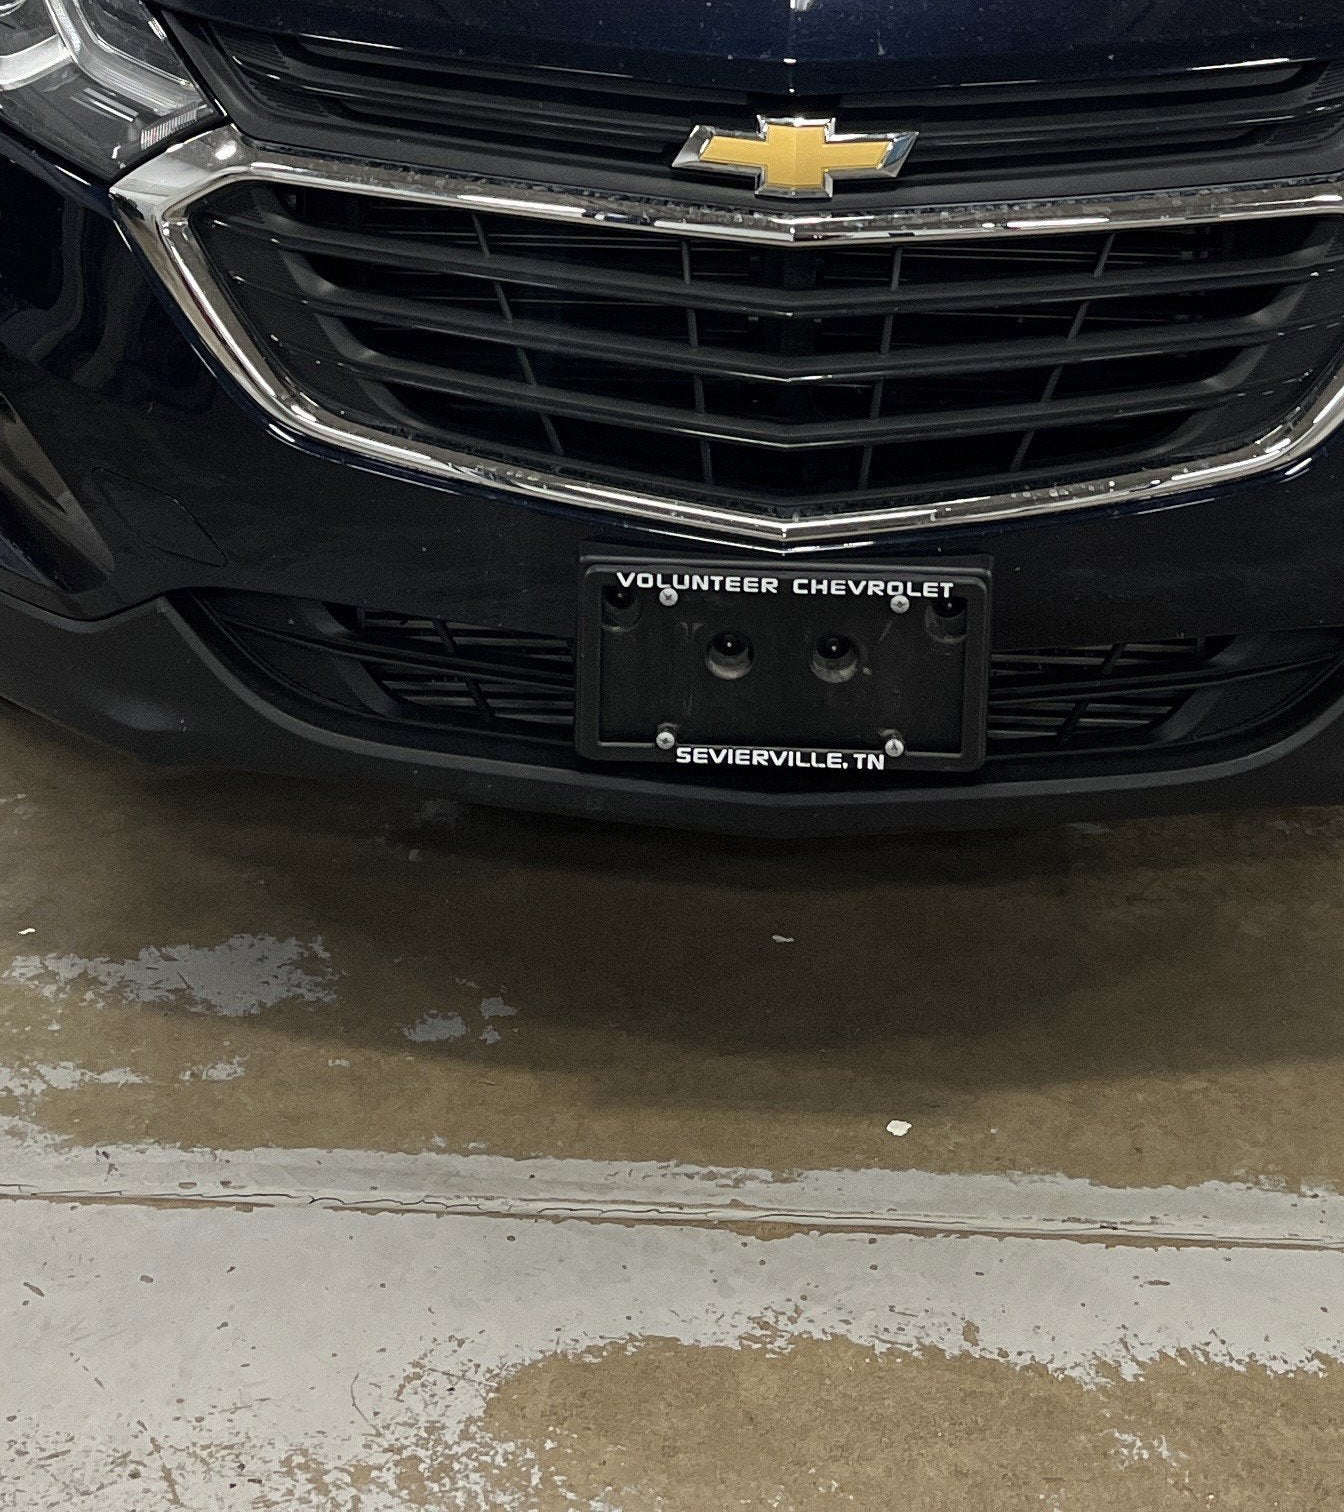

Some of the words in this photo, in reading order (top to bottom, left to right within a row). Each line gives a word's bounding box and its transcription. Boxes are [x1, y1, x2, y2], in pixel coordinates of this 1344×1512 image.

[616, 571, 779, 594] VOLUNTEER
[792, 578, 954, 599] CHEVROLET
[676, 747, 849, 770] SEVIERVILLE,
[853, 753, 885, 770] TN
